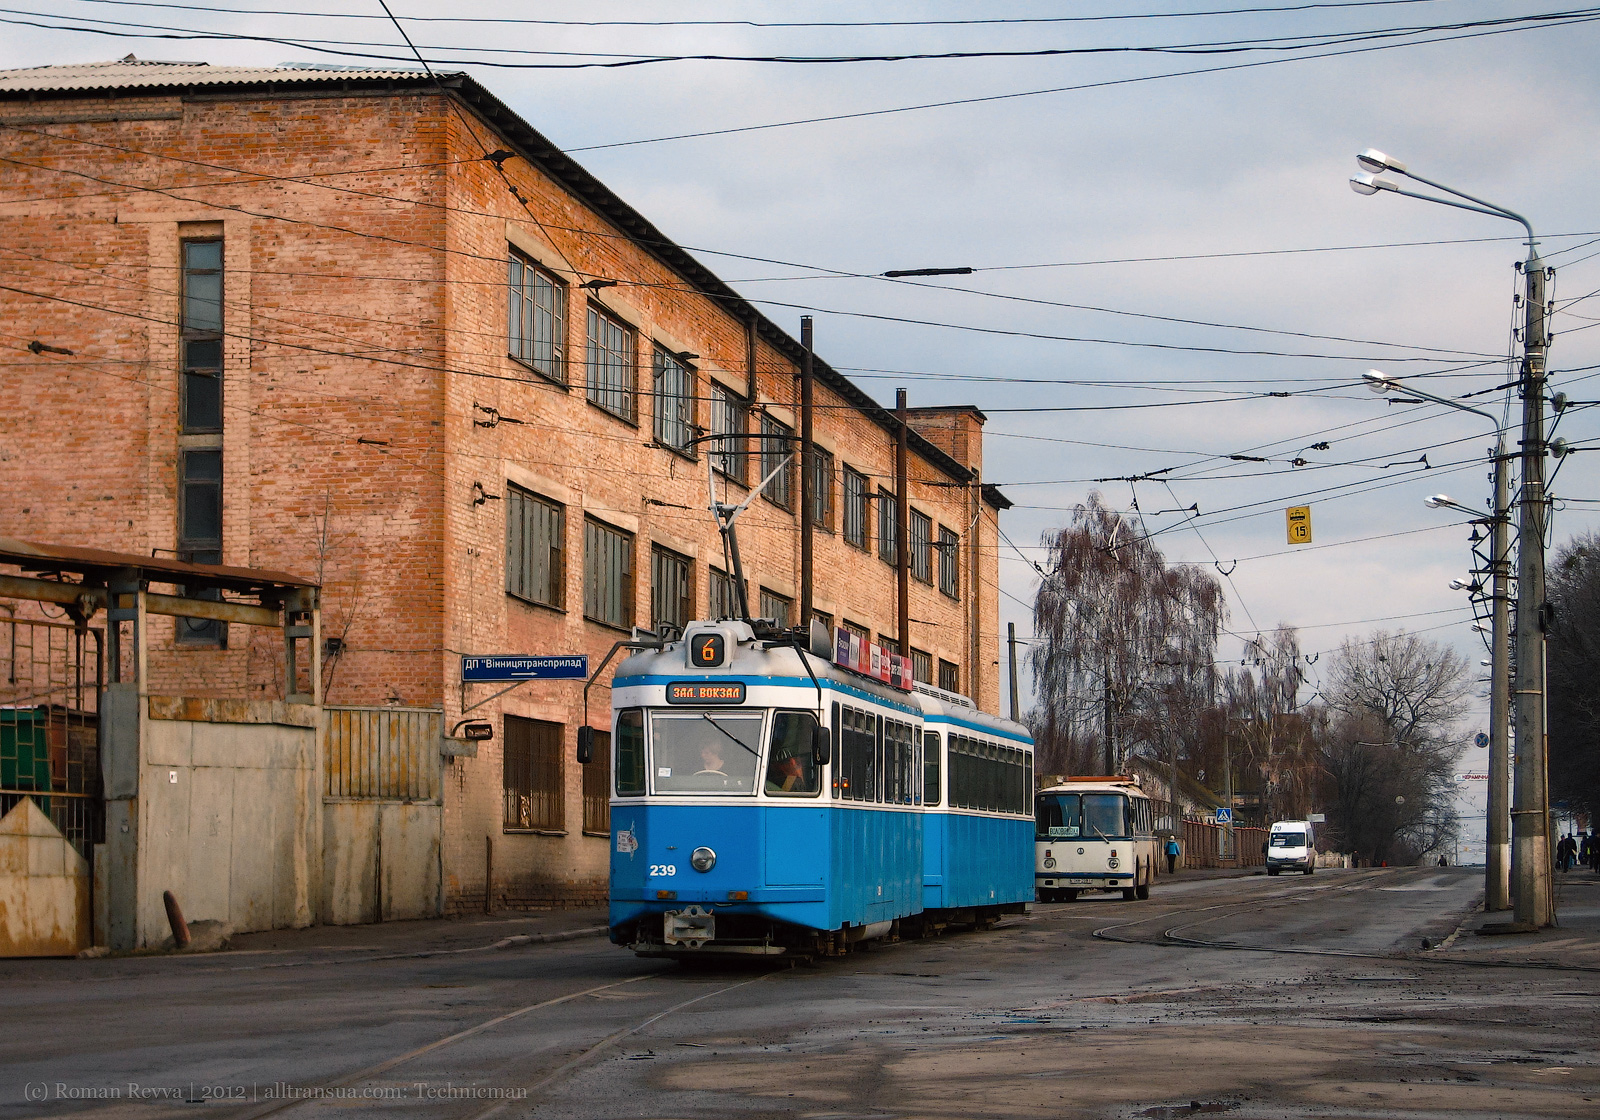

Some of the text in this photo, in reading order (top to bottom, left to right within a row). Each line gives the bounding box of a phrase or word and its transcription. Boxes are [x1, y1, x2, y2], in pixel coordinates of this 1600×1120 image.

[1295, 526, 1306, 537] 15
[702, 638, 715, 661] 6
[465, 657, 586, 671] ДП "Вінницятрансприлад"
[699, 687, 740, 698] ВОКЗАЛ
[650, 865, 676, 876] 239
